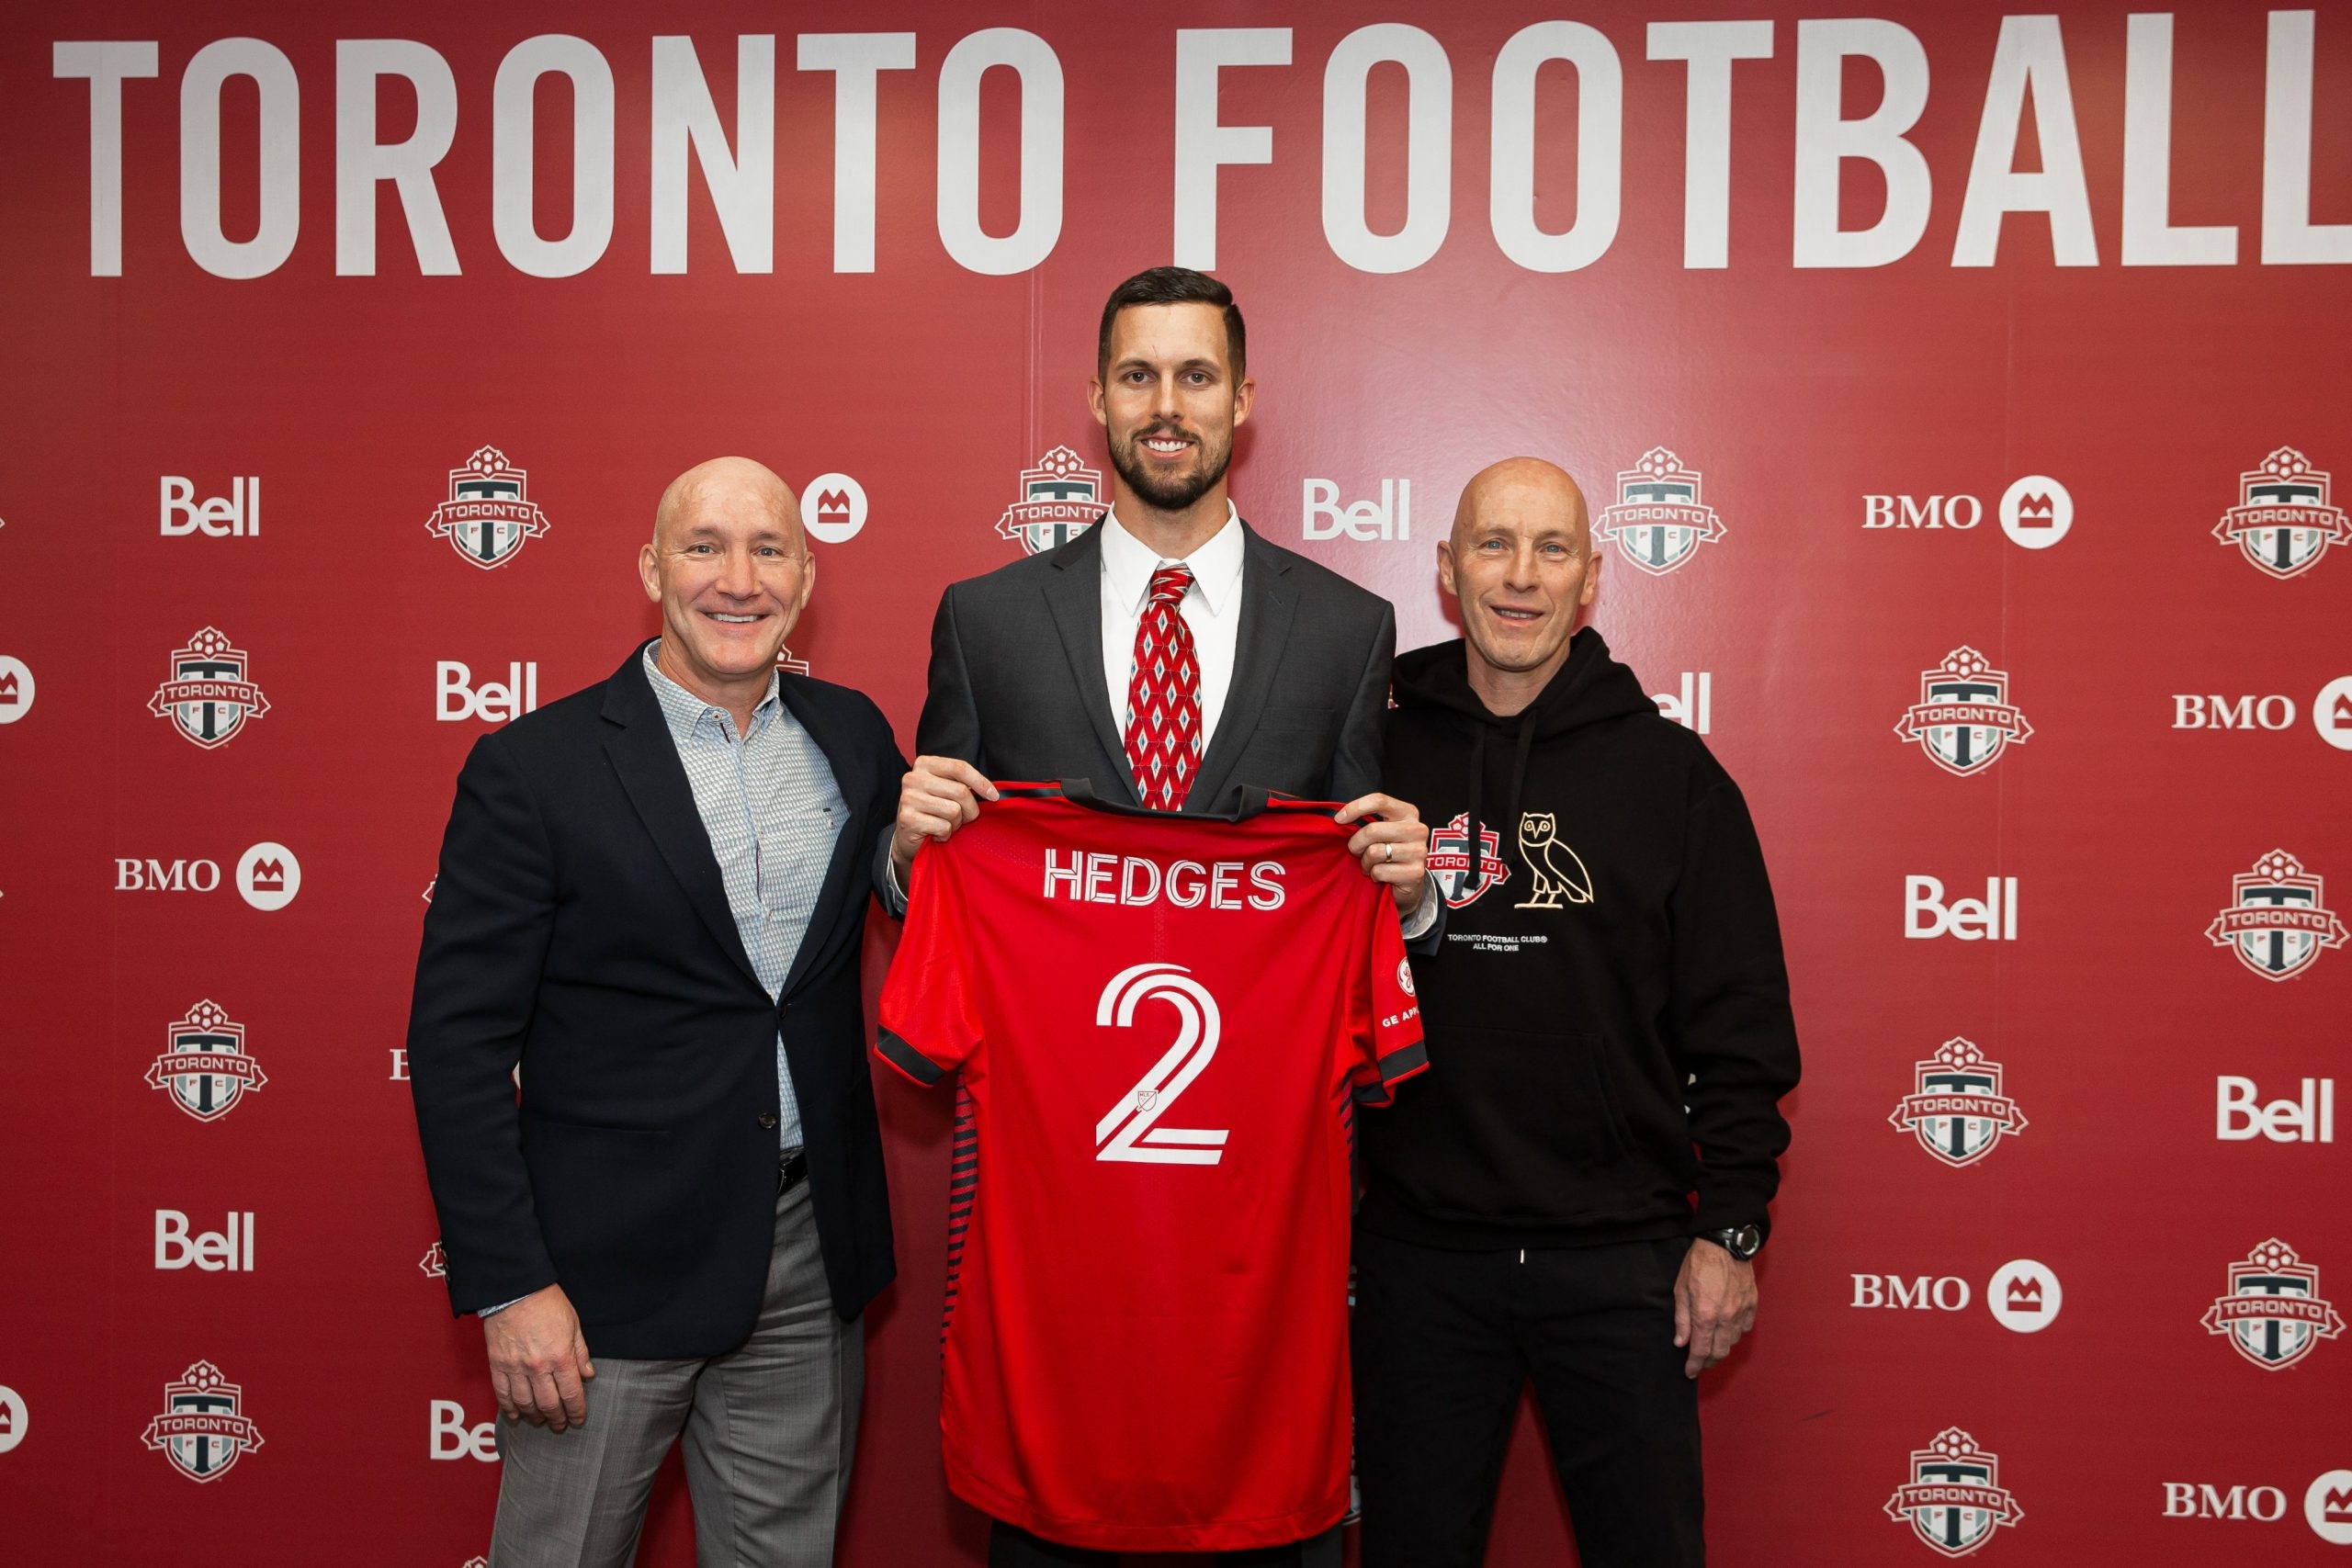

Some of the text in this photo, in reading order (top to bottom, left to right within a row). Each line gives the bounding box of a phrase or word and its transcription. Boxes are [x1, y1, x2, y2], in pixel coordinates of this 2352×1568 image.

[53, 10, 2352, 280] TORONTO FOOTBALL
[161, 476, 260, 537] Bell
[446, 504, 529, 519] TORONTO
[1303, 478, 1410, 541] Bell
[1612, 508, 1704, 523] TORONTO
[1861, 494, 1983, 529] BMO
[2235, 508, 2333, 525] TORONTO
[167, 684, 250, 699] TORONTO
[435, 660, 537, 723] Bell
[1649, 671, 1711, 734] ell
[1917, 706, 2011, 724] TORONTO
[2171, 694, 2296, 729] BMO
[114, 858, 220, 892] BMO
[1426, 856, 1497, 871] TOROTO
[1044, 848, 1286, 910] HEDGES
[1905, 874, 2018, 941] Bell
[2229, 911, 2325, 929] TORONTO
[1482, 935, 1520, 943] FOOTBALL
[1487, 943, 1502, 952] FOR
[1382, 1014, 1399, 1027] GE
[164, 1057, 247, 1073] TORONTO
[1095, 963, 1230, 1166] 2
[1911, 1098, 2006, 1115] TORONTO
[2216, 1075, 2334, 1144] Bell
[154, 1209, 254, 1272] Bell
[1849, 1273, 1971, 1312] BMO
[2223, 1301, 2322, 1318] TORONTO
[161, 1418, 243, 1434] TORONTO
[1906, 1488, 2001, 1506] TORONTO
[2162, 1482, 2287, 1522] BMO
